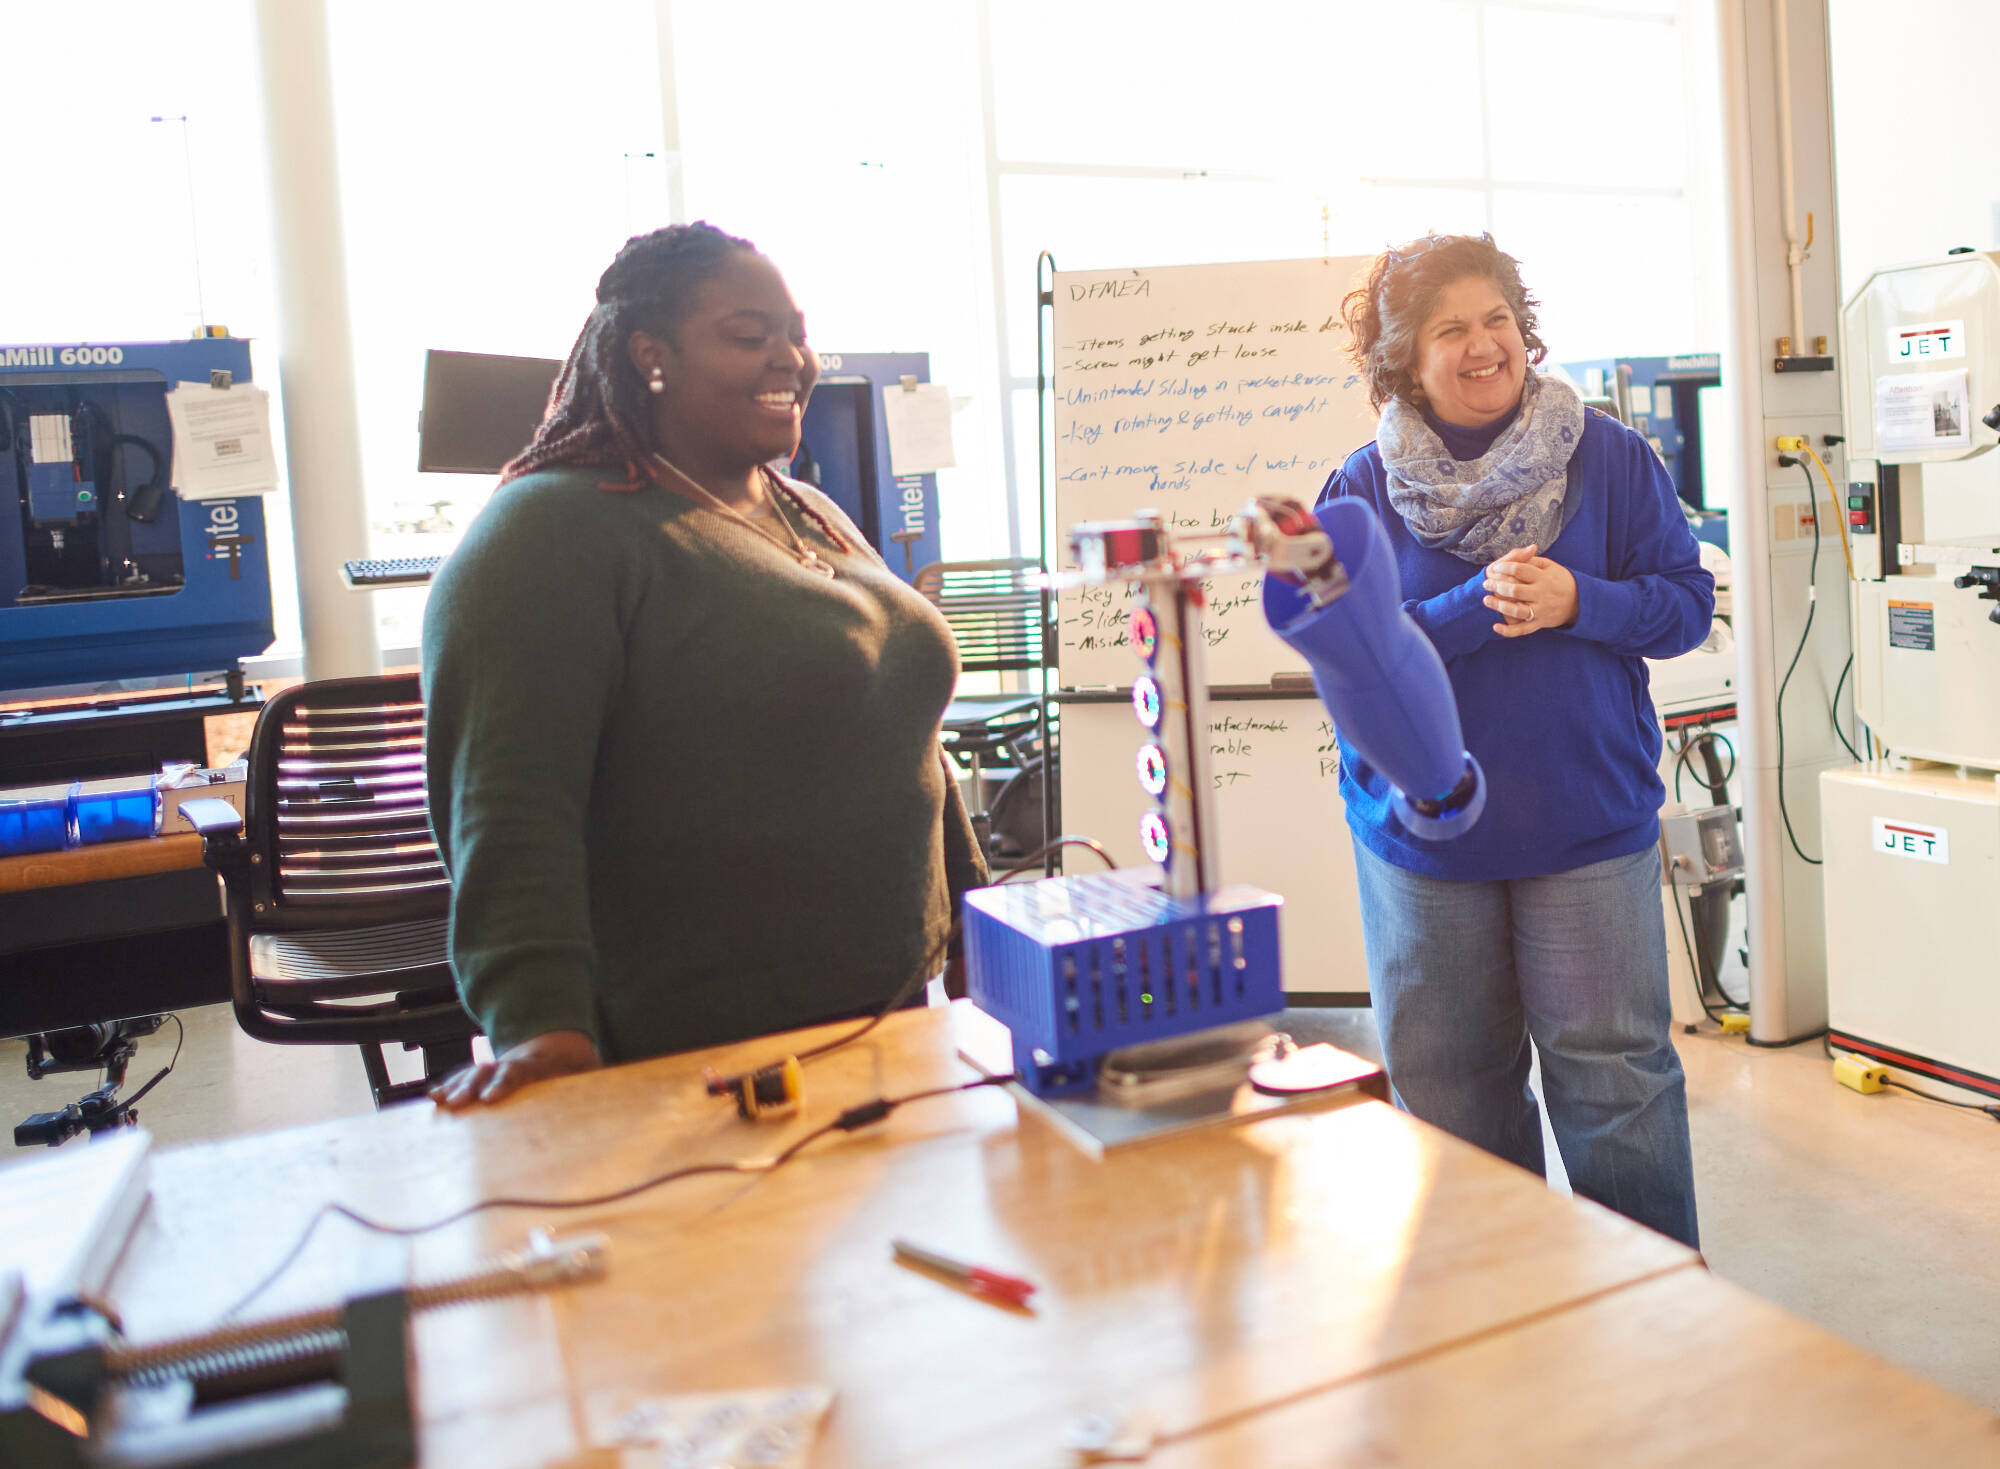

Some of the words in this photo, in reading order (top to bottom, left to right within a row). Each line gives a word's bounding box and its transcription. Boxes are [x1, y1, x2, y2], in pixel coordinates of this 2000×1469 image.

[1070, 279, 1150, 302] DFMEA
[1139, 327, 1195, 347] getting
[1270, 318, 1310, 333] inside
[60, 346, 124, 366] 6000
[1128, 350, 1180, 370] might
[1187, 344, 1229, 368] get
[1234, 344, 1279, 360] loose
[1900, 336, 1952, 357] JET
[1114, 412, 1173, 434] rotating
[1262, 396, 1329, 422] caught
[1115, 464, 1160, 476] move
[1265, 455, 1303, 472] wet
[1308, 457, 1330, 470] or
[1172, 510, 1201, 528] too
[1210, 508, 1234, 534] big
[1209, 595, 1258, 616] tight
[1884, 834, 1937, 856] JET
